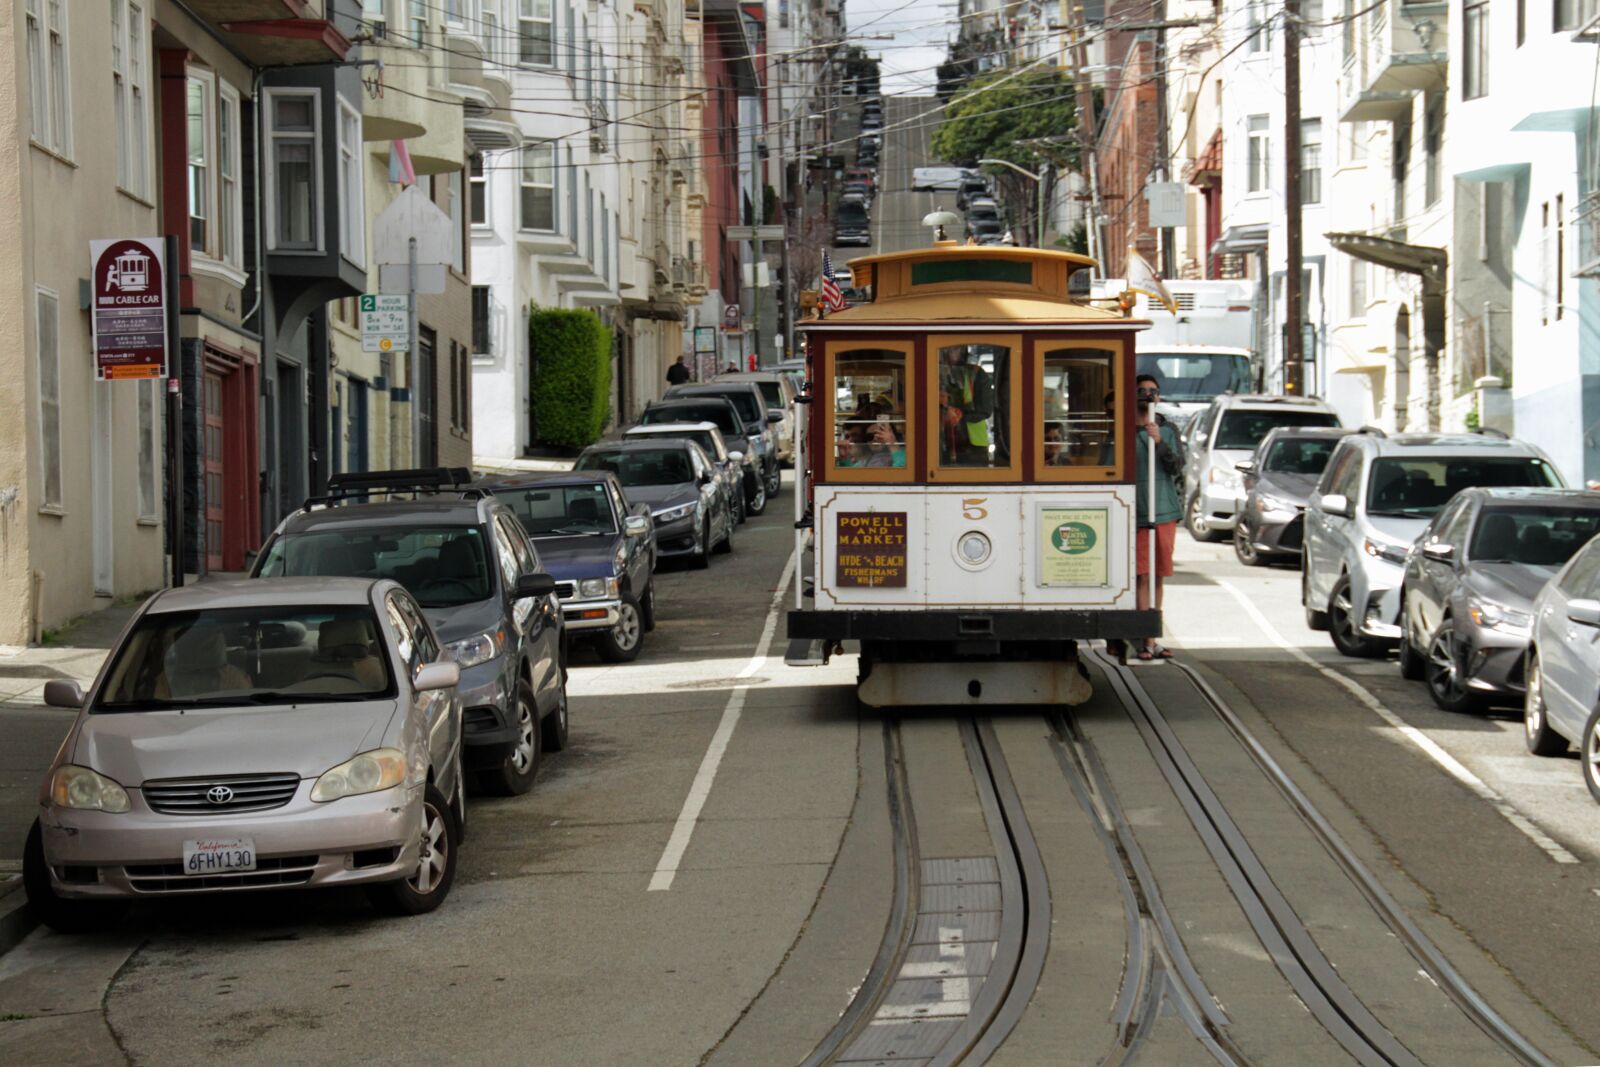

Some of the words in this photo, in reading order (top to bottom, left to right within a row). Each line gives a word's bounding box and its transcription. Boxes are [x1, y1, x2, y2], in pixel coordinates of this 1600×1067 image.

[115, 296, 141, 304] CABLE
[142, 295, 159, 303] CAR
[363, 297, 373, 310] 2
[962, 497, 988, 520] 5
[840, 517, 903, 527] POWELL
[857, 527, 888, 535] AND
[839, 535, 904, 545] MARKET
[839, 555, 861, 566] HYDE
[875, 555, 904, 566] BEACH
[844, 568, 898, 576] FISHERMANS
[197, 841, 242, 852] California
[188, 850, 251, 871] 6FHY130
